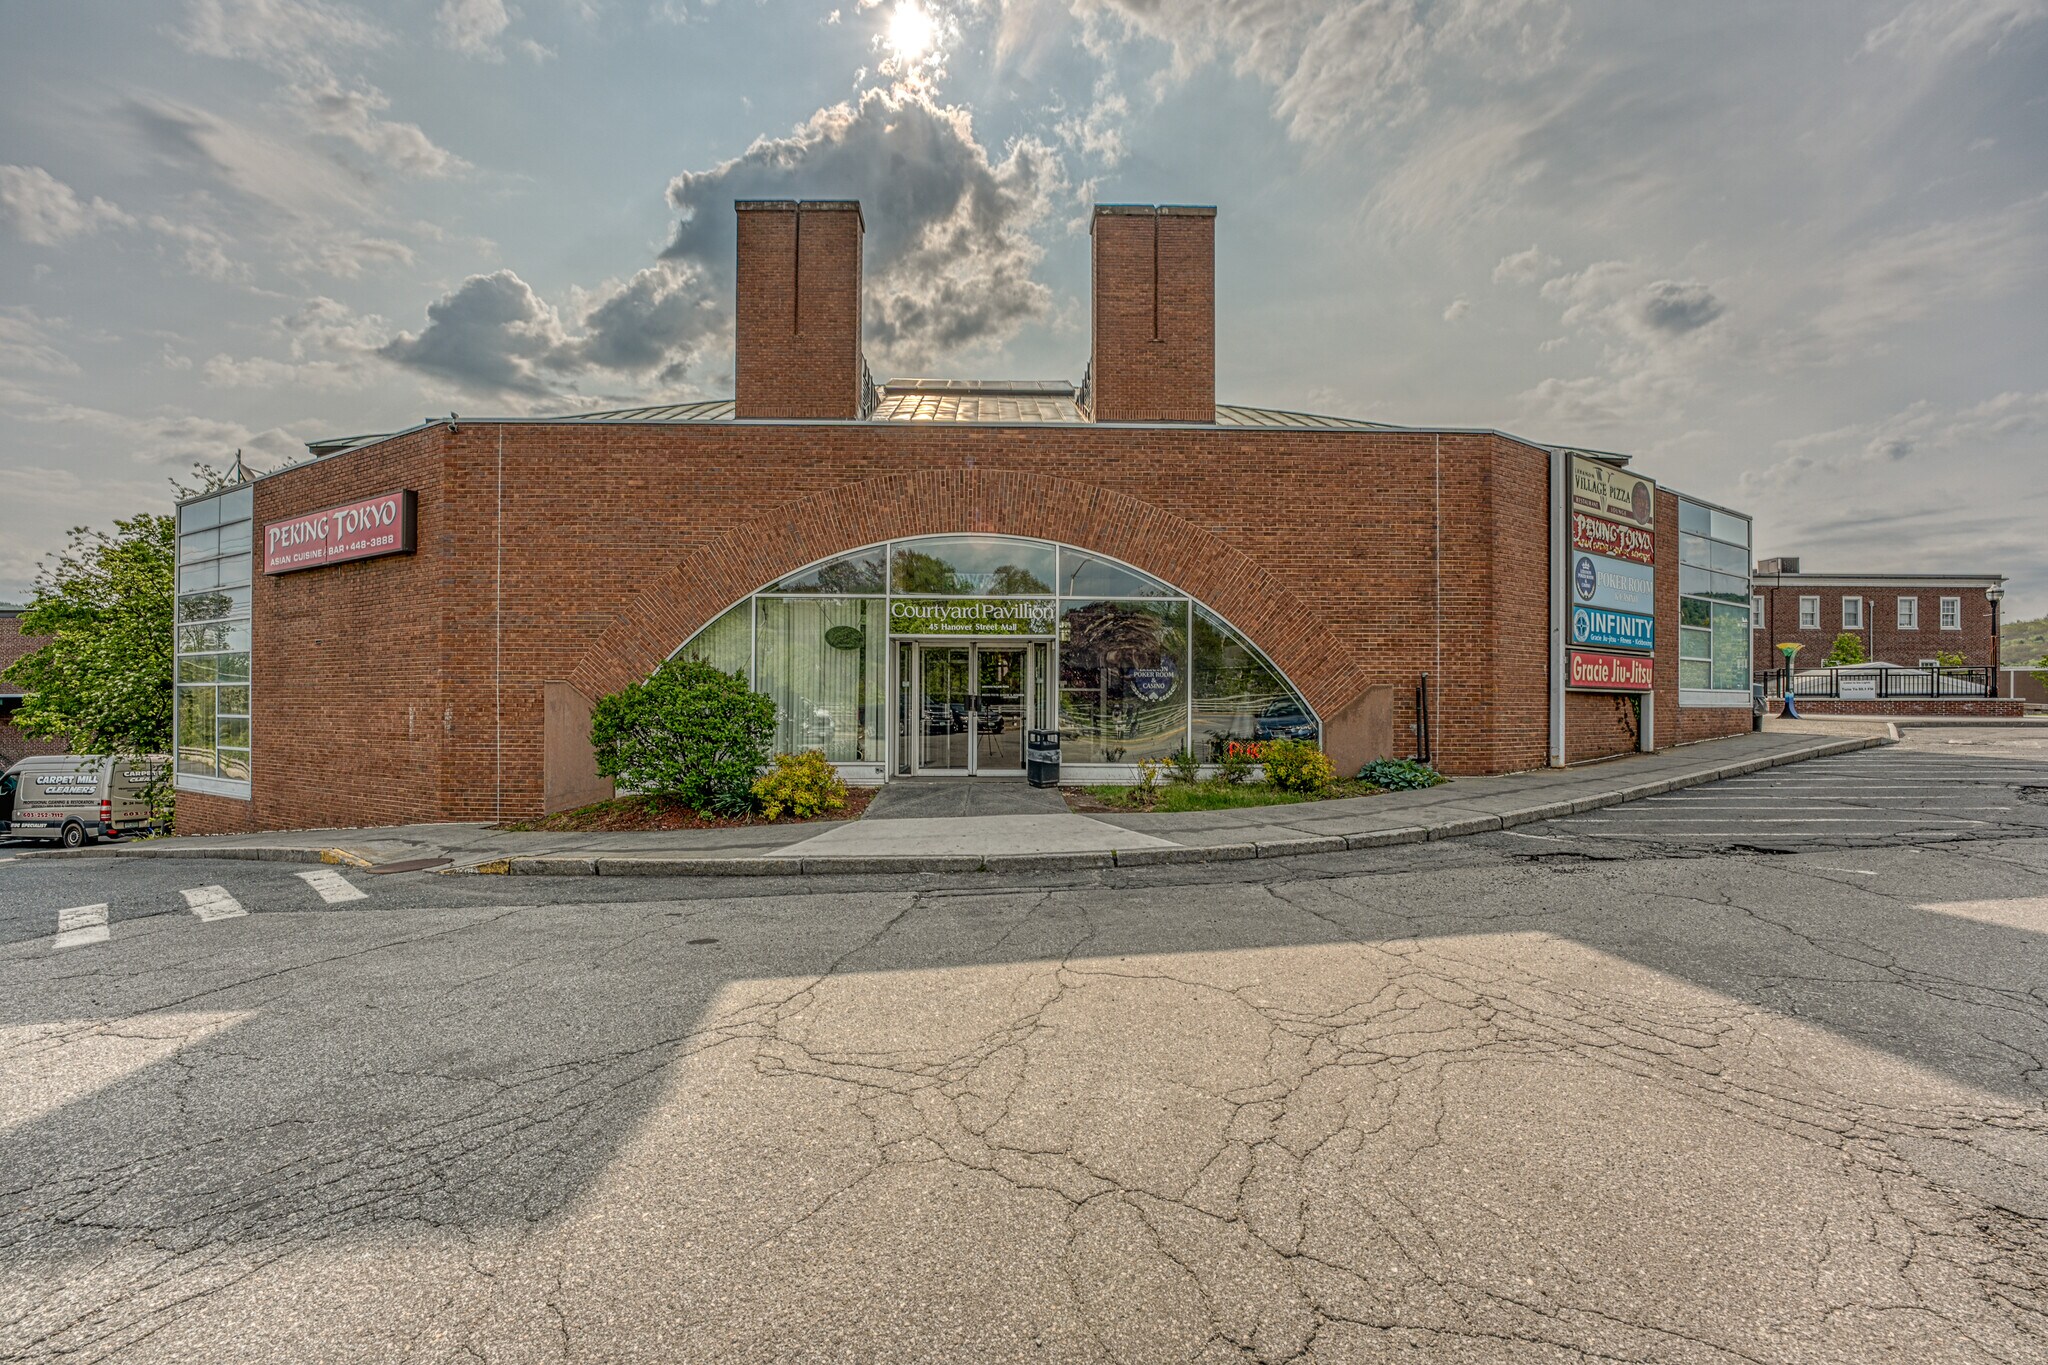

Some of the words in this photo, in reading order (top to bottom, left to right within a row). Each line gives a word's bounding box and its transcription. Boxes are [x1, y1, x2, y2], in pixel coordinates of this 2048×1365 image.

[1575, 475, 1607, 496] VILLAGE
[1609, 486, 1631, 503] PIZZA
[1575, 497, 1599, 508] RESTAURANT
[1610, 507, 1627, 516] LOUNGE
[269, 516, 329, 554] PEKING
[332, 500, 397, 541] TOKYO
[1617, 525, 1654, 555] TOKYO
[270, 555, 292, 567] ASIAN
[293, 549, 322, 562] CUISINE
[328, 544, 344, 556] BAR
[350, 534, 394, 551] 448-3888
[1597, 571, 1627, 590] POKER
[891, 602, 980, 621] Courtyard
[981, 602, 1055, 619] Pavillion
[928, 623, 939, 631] 45
[941, 623, 972, 631] Hanover
[975, 623, 998, 631] Street
[1590, 612, 1653, 638] INFINITY
[1573, 655, 1609, 682] Gracie
[1611, 658, 1653, 684] Jiu-Jitsu
[36, 775, 74, 785] CARPET
[76, 775, 98, 785] MILL
[44, 786, 97, 795] CLEANERS
